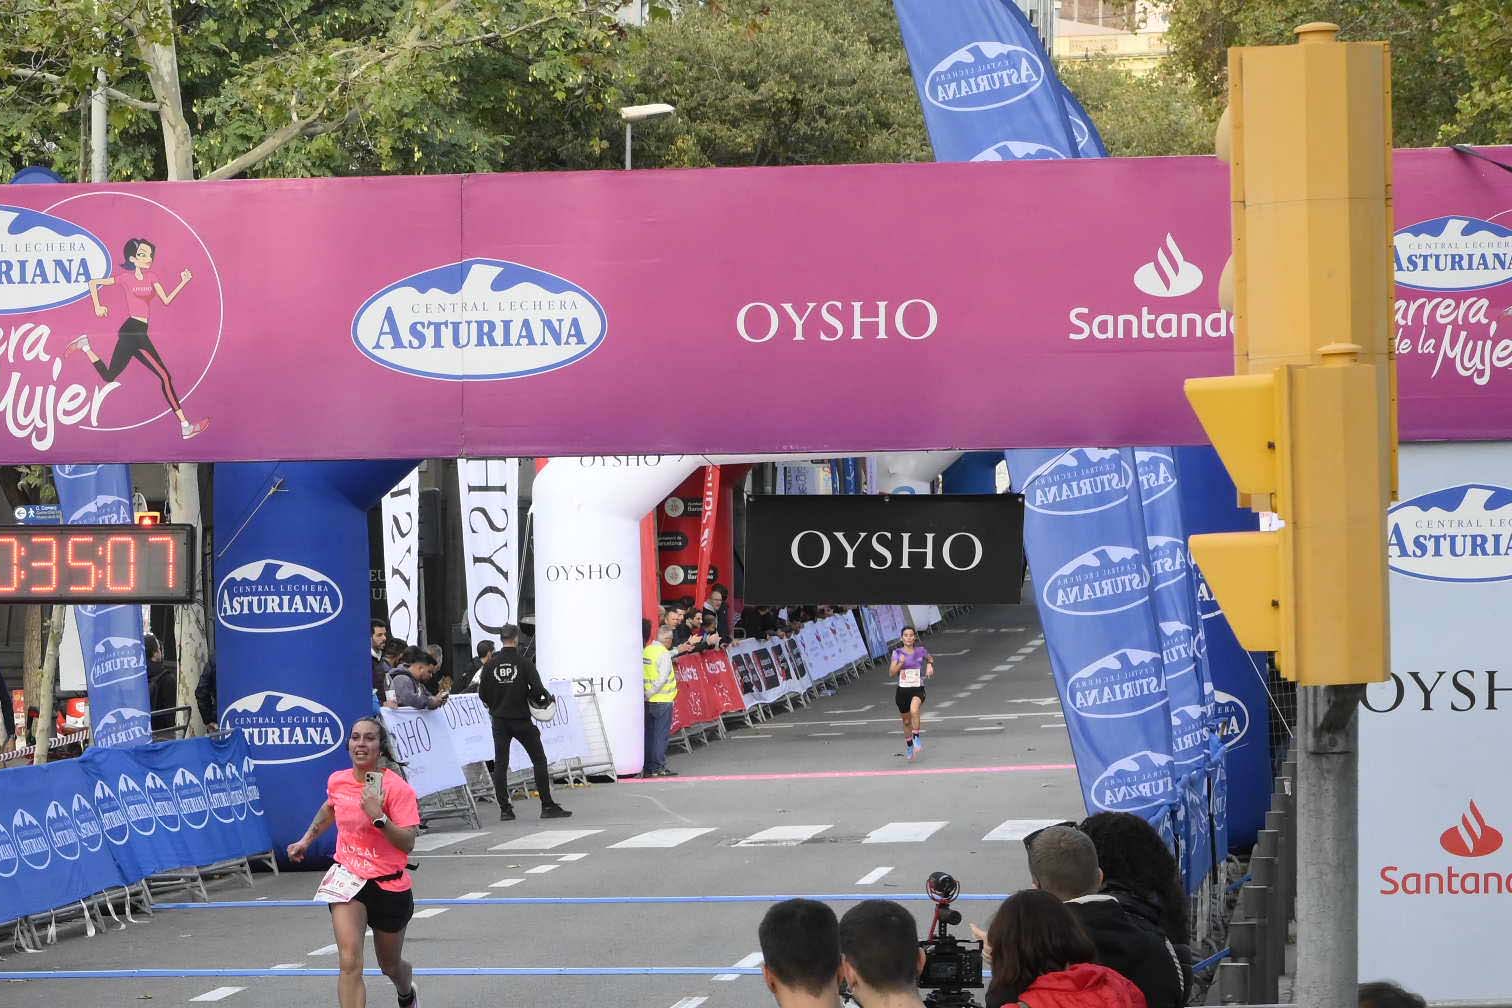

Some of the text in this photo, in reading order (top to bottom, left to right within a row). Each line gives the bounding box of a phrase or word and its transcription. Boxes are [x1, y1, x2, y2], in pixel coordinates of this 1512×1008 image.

[15, 242, 87, 253] LECHERA
[1408, 240, 1512, 250] CENTRAL LECHER
[411, 299, 578, 315] CENTRAL LECHERA
[736, 299, 937, 343] OYSHO
[1393, 297, 1489, 326] arrera
[373, 306, 586, 350] ASTURIANA
[1069, 307, 1234, 339] Santand
[1417, 325, 1435, 354] la
[1431, 323, 1512, 386] Muje
[1415, 519, 1483, 529] CENTRAL
[791, 530, 983, 571] OYSHO
[1388, 523, 1512, 558] ASTURI
[546, 562, 621, 582] OYSHO
[233, 583, 329, 594] CENTRAL LECHERA
[221, 589, 334, 617] ASTURIANA
[499, 667, 512, 677] BP
[1361, 670, 1512, 713] OYSH
[235, 716, 329, 725] CENTRAL LECHERA
[1379, 866, 1512, 896] Santan
